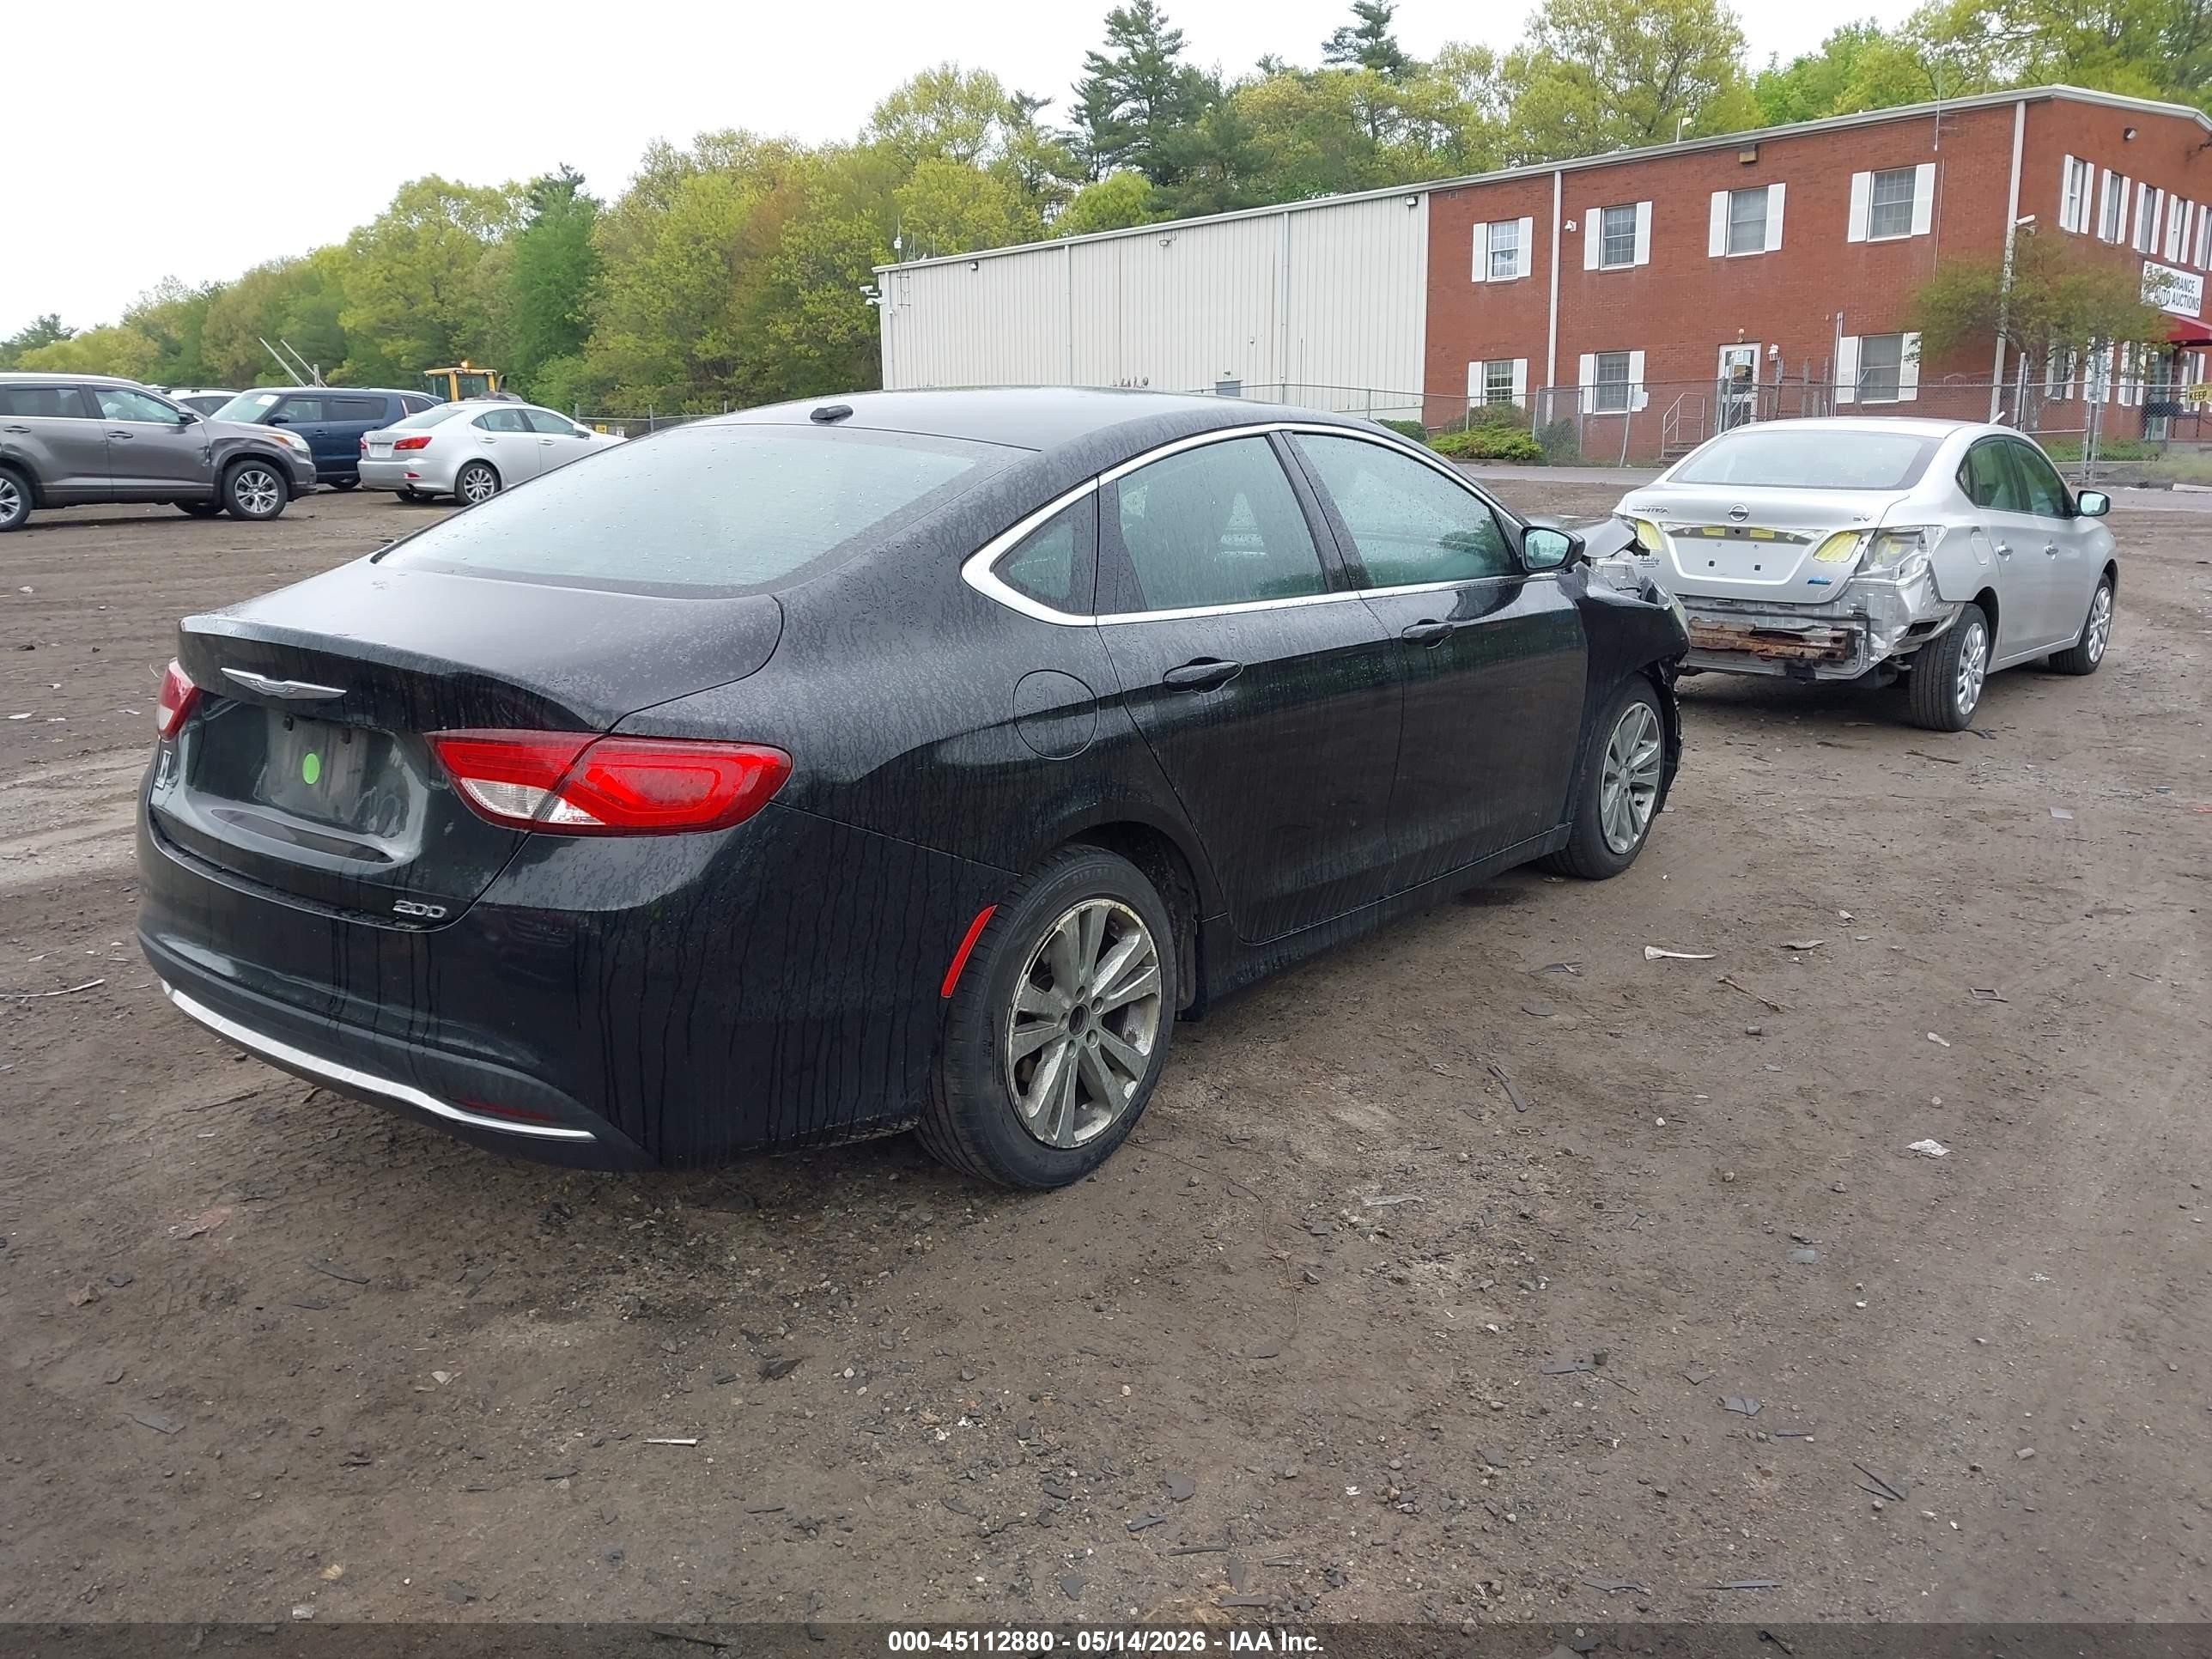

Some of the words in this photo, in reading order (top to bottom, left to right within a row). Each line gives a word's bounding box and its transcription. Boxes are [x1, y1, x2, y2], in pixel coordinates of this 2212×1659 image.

[2154, 286, 2171, 305] AUTO
[2172, 293, 2200, 311] AUCTIONS
[2189, 391, 2207, 401] KEEP
[392, 899, 447, 919] 200
